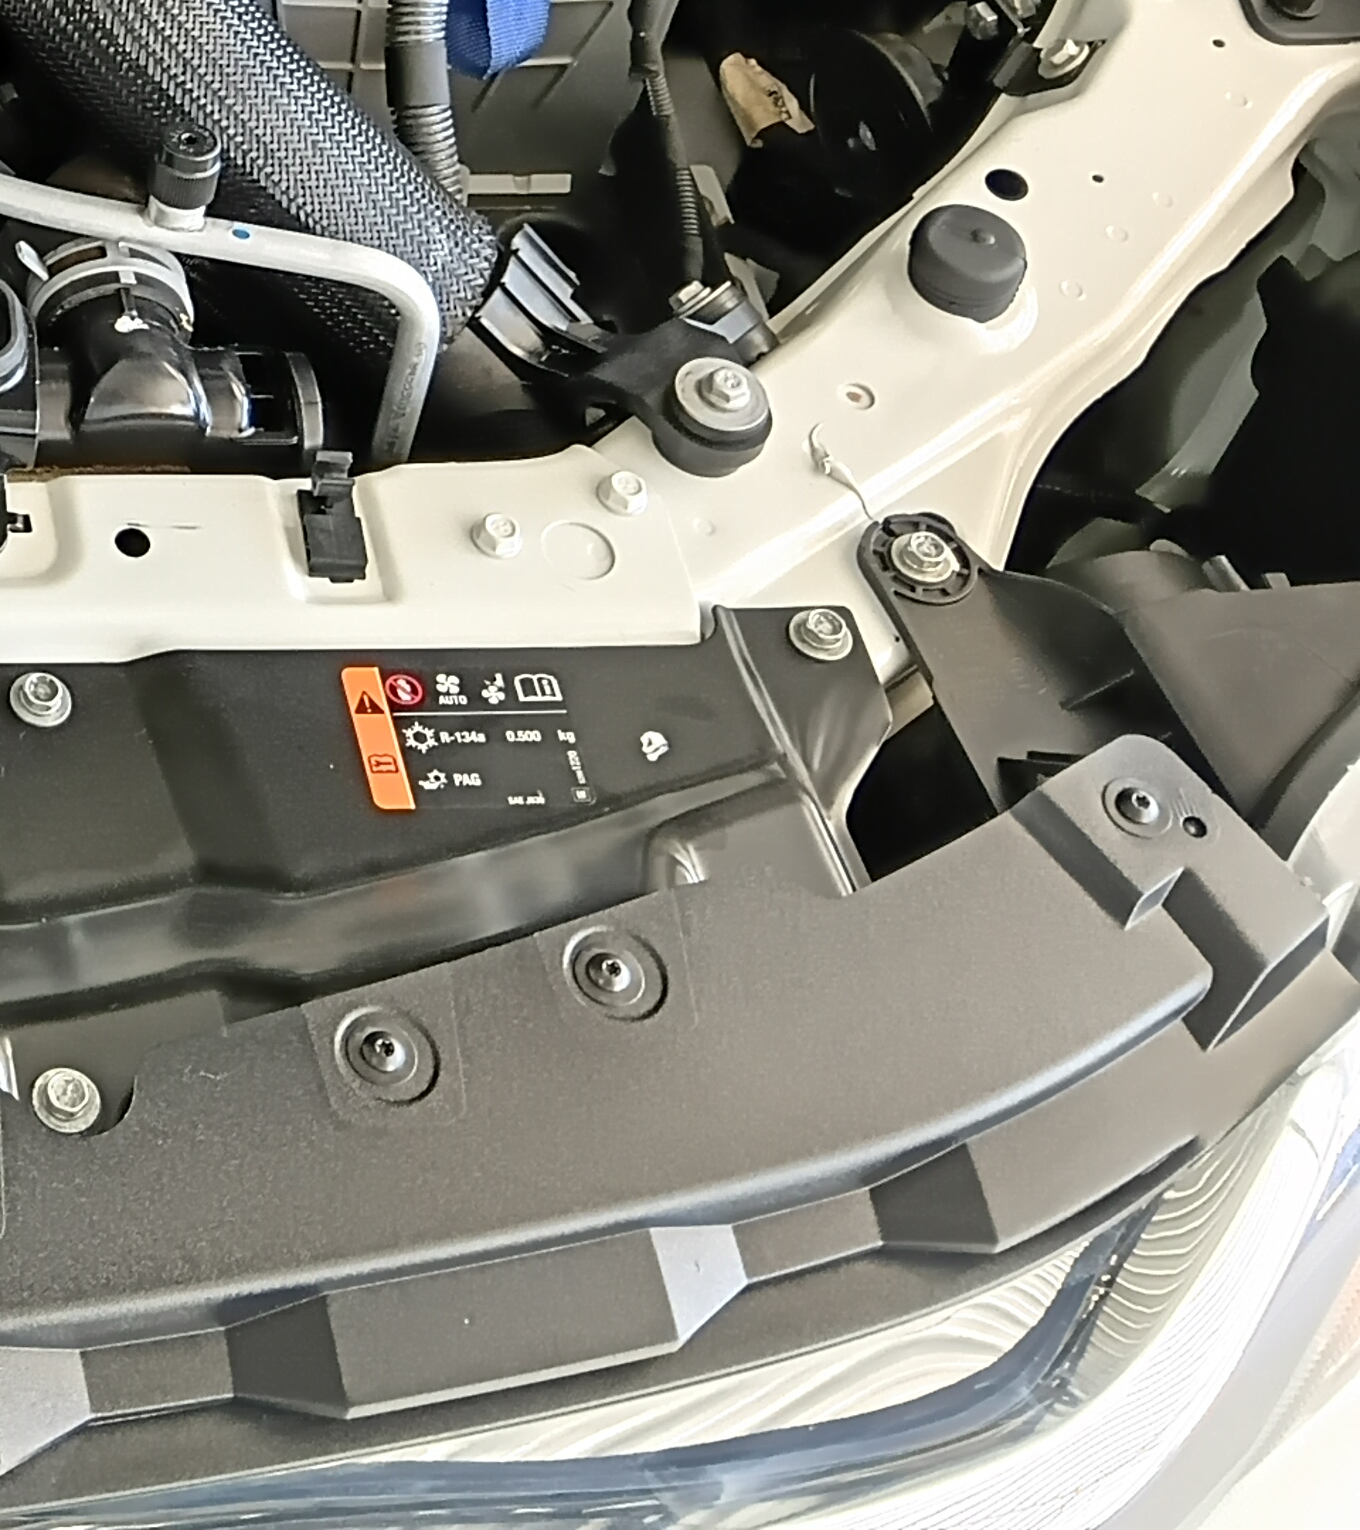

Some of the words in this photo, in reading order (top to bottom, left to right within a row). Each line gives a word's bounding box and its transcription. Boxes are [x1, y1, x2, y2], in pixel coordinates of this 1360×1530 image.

[438, 695, 468, 706] AUTO
[439, 729, 486, 744] R-134a
[505, 730, 542, 743] 0.500
[557, 729, 576, 744] kg
[452, 773, 482, 787] PAG
